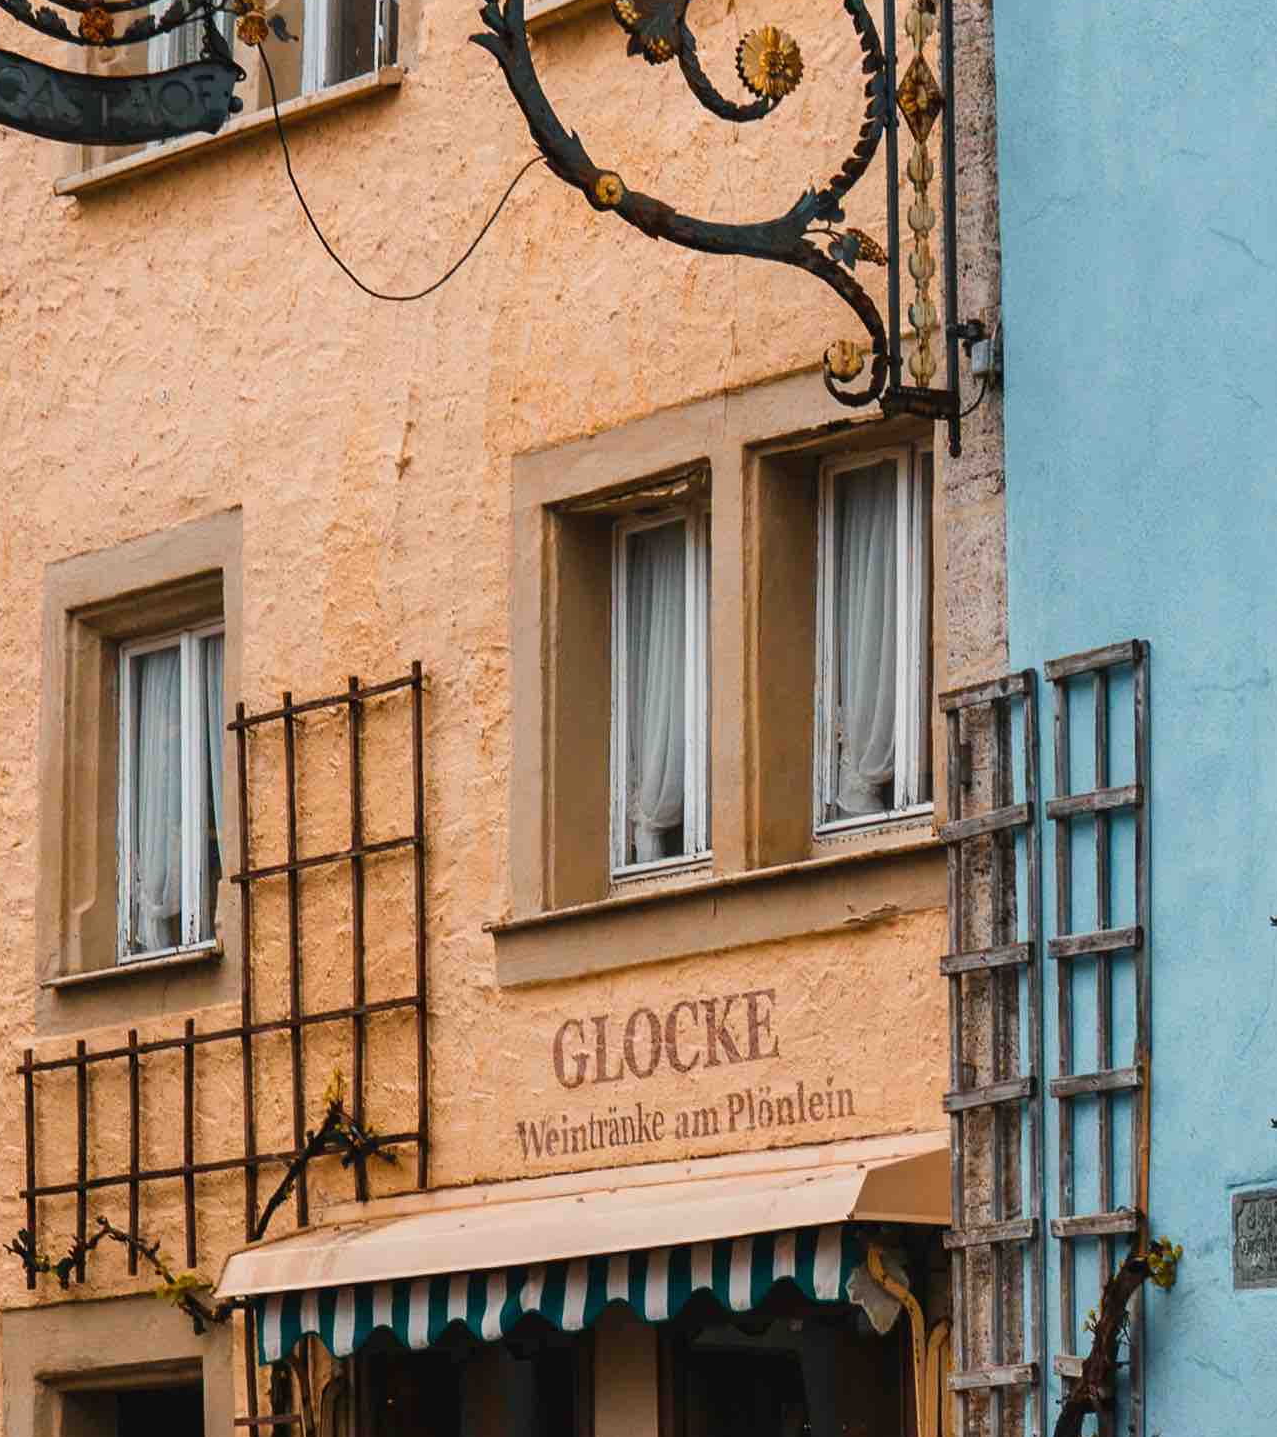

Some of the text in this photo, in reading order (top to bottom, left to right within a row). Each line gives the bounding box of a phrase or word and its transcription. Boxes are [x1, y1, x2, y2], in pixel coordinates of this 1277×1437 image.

[553, 987, 780, 1089] GLOCKE
[516, 1074, 857, 1161] Weintränke am Plönlein
